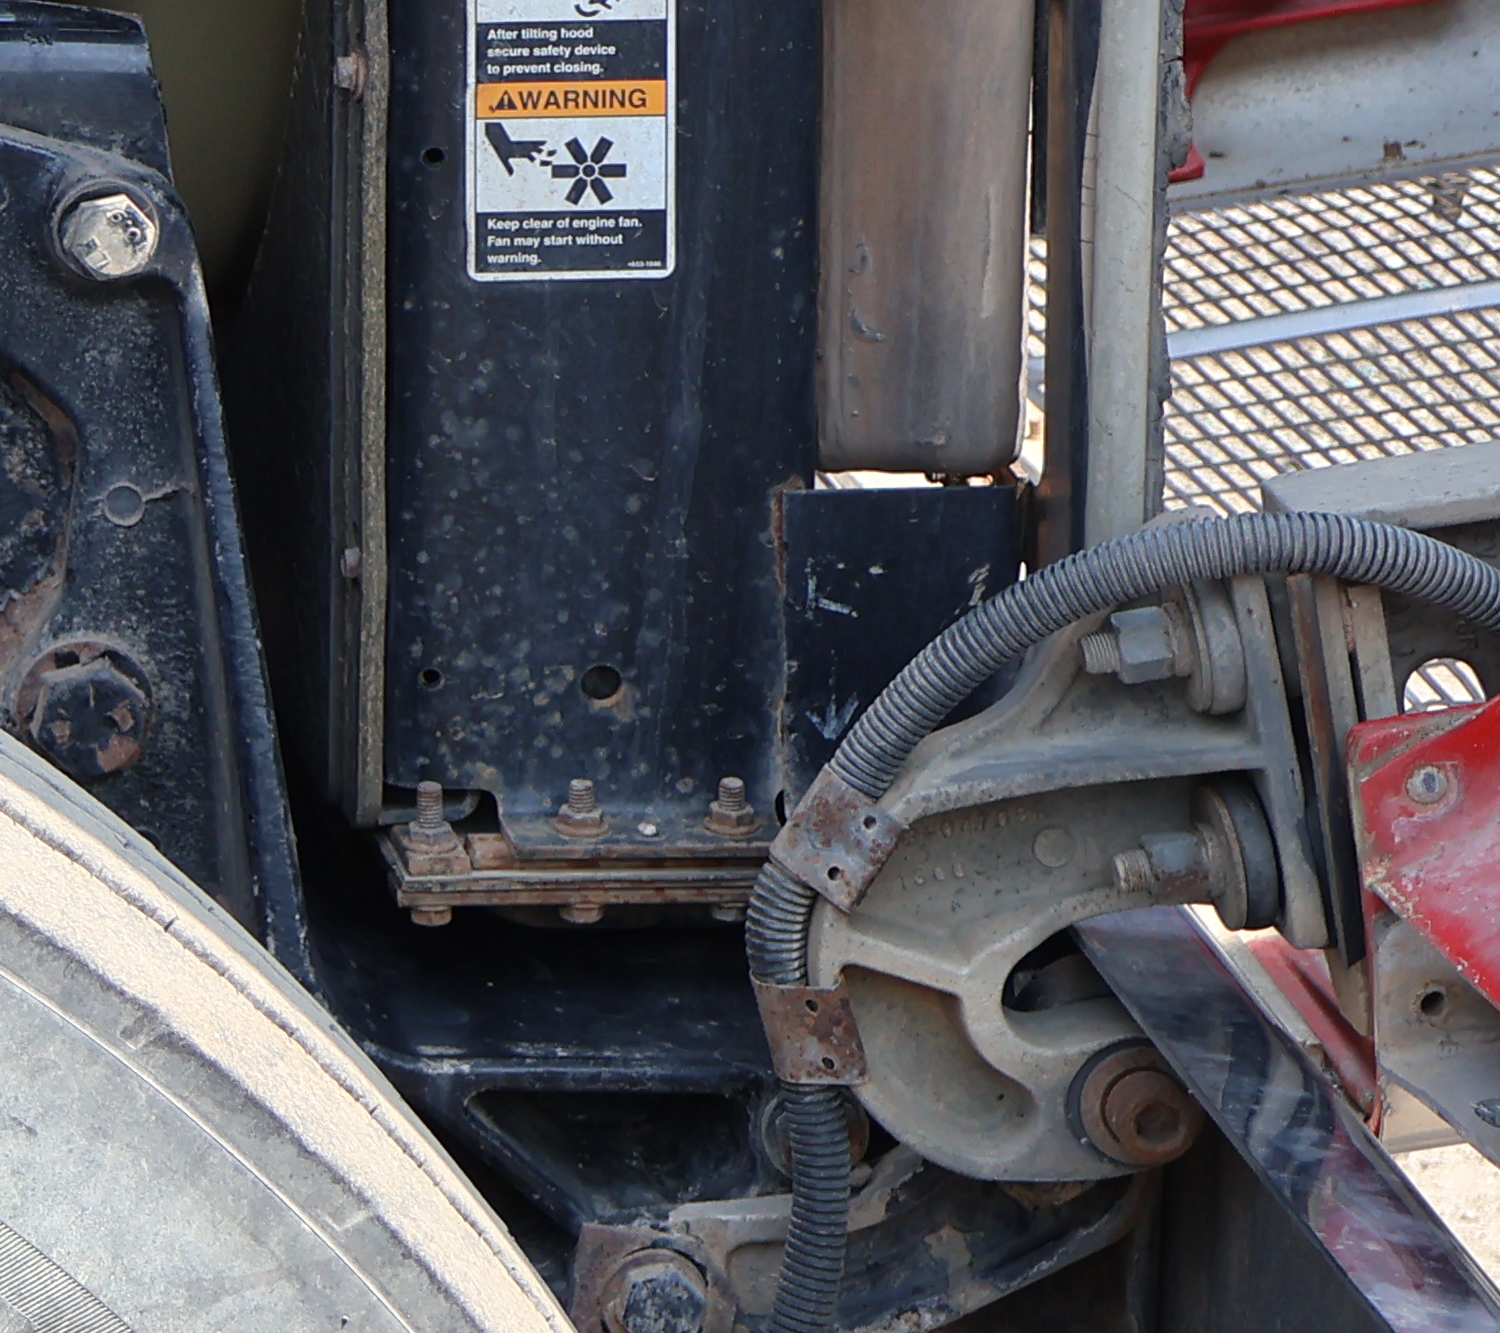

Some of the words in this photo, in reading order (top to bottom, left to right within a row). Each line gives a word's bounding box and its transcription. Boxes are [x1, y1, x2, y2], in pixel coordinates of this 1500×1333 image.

[487, 28, 519, 41] After
[520, 27, 558, 42] tilting
[560, 27, 594, 40] hood
[487, 46, 531, 57] secure
[532, 44, 572, 58] safety
[574, 43, 617, 56] device
[487, 63, 501, 75] to
[503, 62, 551, 77] prevent
[553, 61, 604, 76] closing.
[518, 88, 648, 110] WARNING
[487, 218, 520, 232] Keep
[522, 217, 555, 229] clear
[556, 217, 570, 228] of
[572, 217, 616, 231] engine
[618, 216, 643, 228] fan.
[487, 236, 511, 247] Fan
[513, 237, 541, 248] may
[543, 235, 574, 246] start
[576, 234, 624, 245] without
[487, 252, 542, 266] warning.
